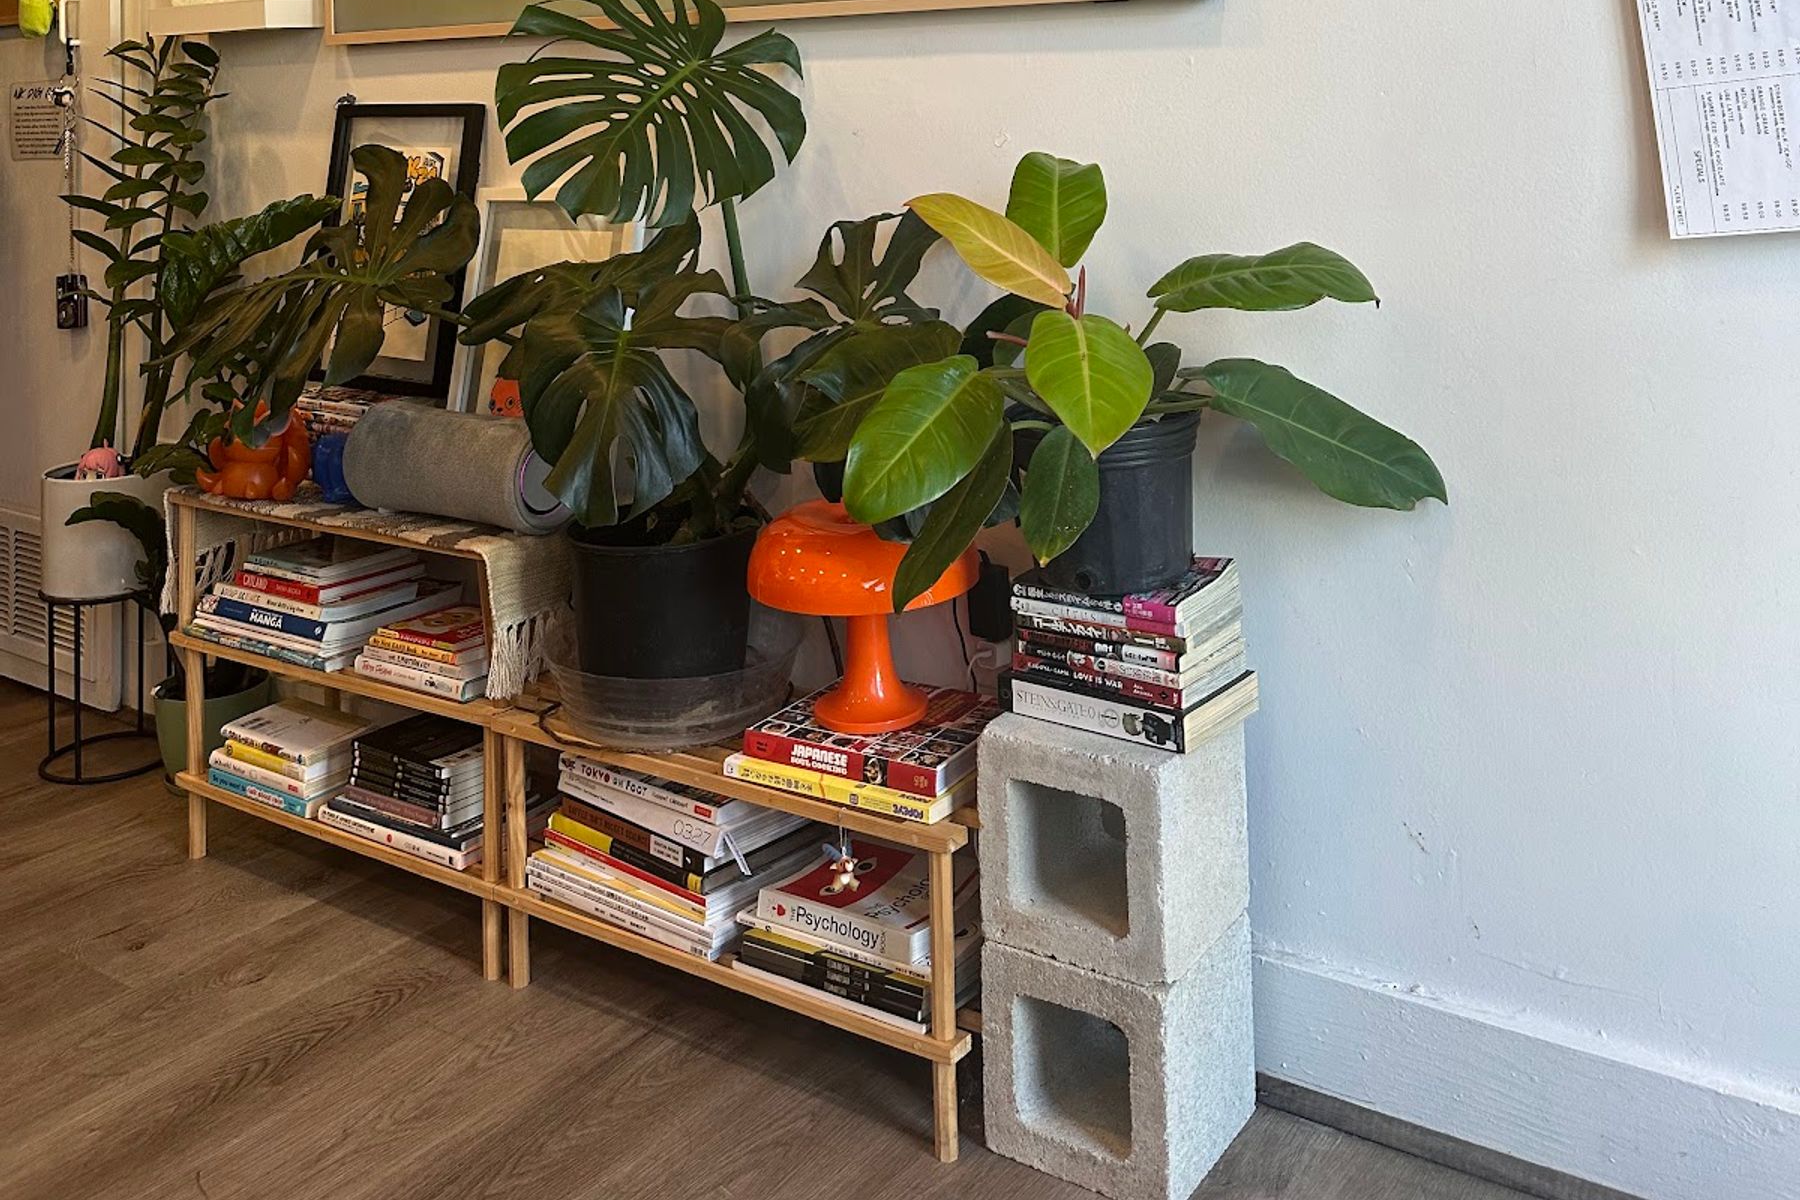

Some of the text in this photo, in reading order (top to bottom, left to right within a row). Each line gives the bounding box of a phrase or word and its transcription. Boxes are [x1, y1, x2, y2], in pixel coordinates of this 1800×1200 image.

[249, 612, 282, 629] MANGA
[1073, 671, 1093, 682] LOVE
[1104, 679, 1123, 689] WAR
[791, 743, 848, 767] JAPANESE
[811, 760, 848, 775] COOKING
[580, 764, 611, 783] TOKYO
[625, 780, 648, 796] FOOT
[673, 819, 712, 847] 0327
[864, 878, 930, 919] Psycholo
[796, 906, 881, 948] Psychology
